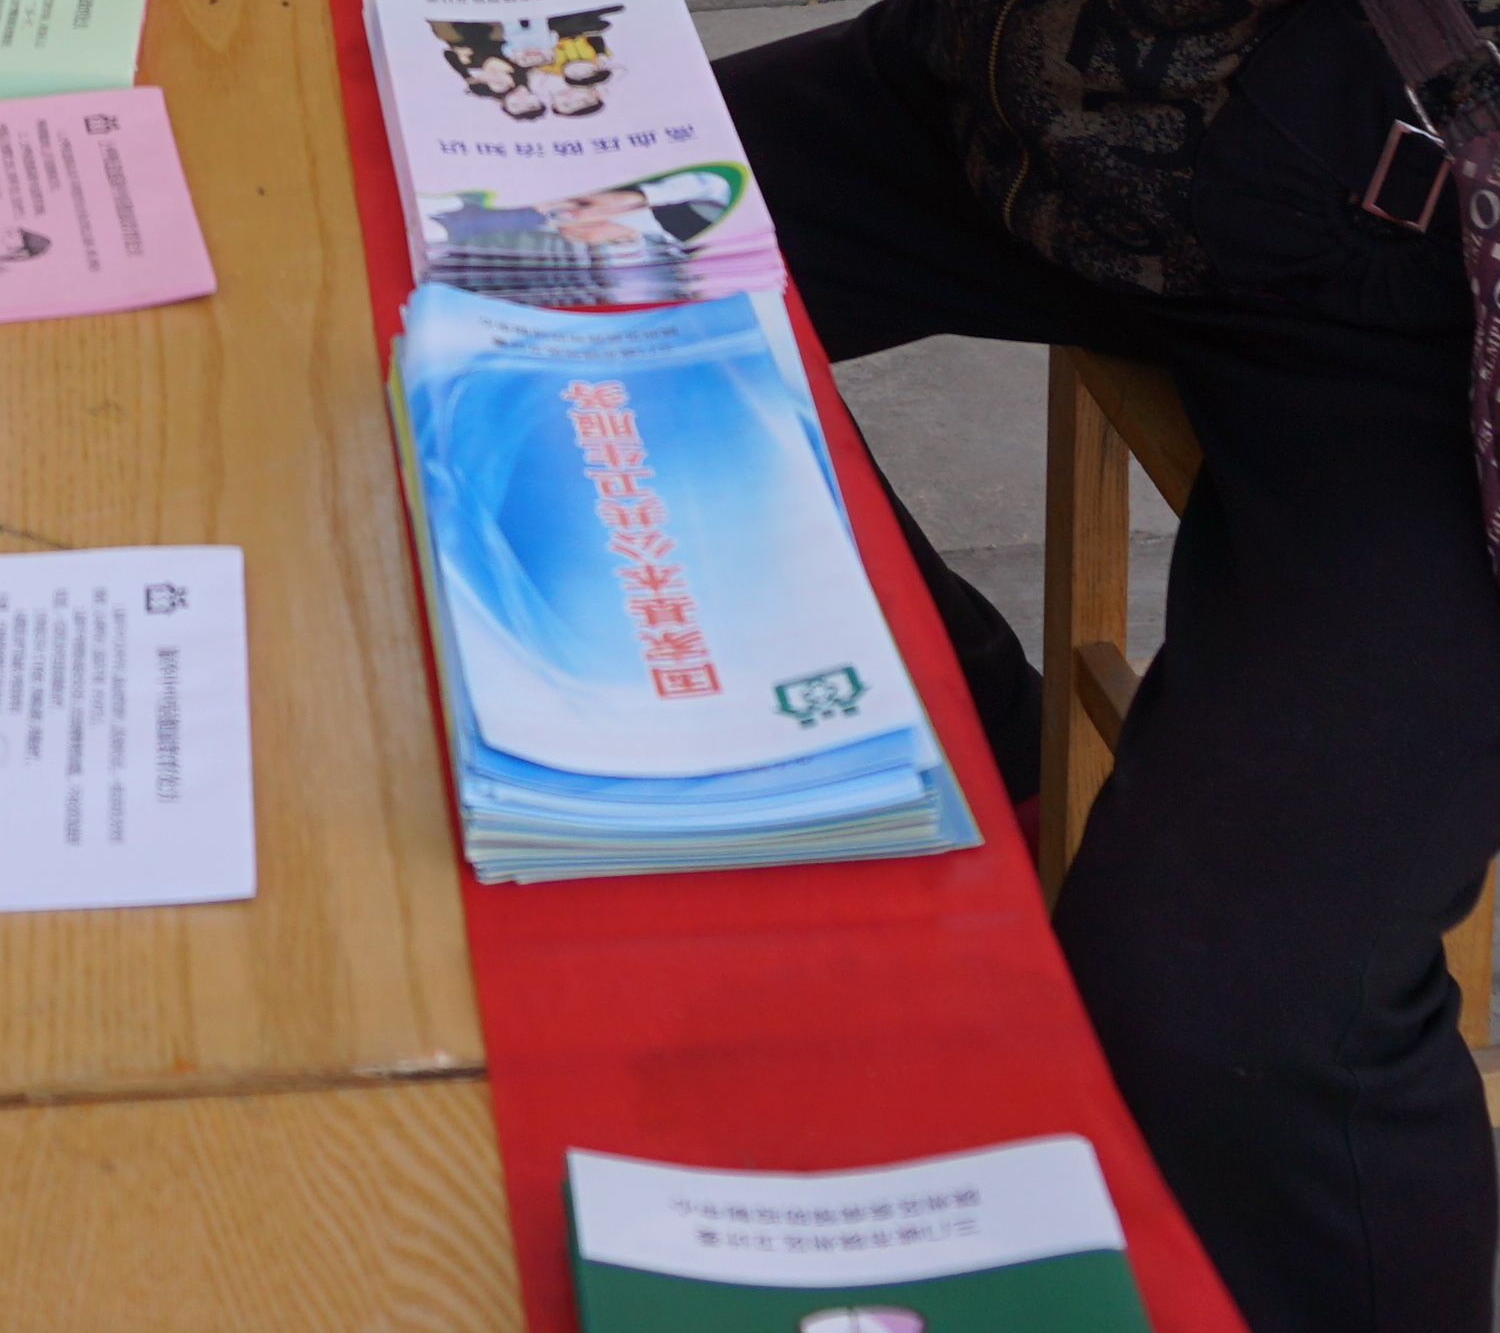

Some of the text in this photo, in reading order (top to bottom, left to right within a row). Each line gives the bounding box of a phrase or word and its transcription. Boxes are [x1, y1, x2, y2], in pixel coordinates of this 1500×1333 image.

[438, 122, 699, 159] 高血压防治知识
[558, 379, 722, 699] 国家基本公共卫生服务
